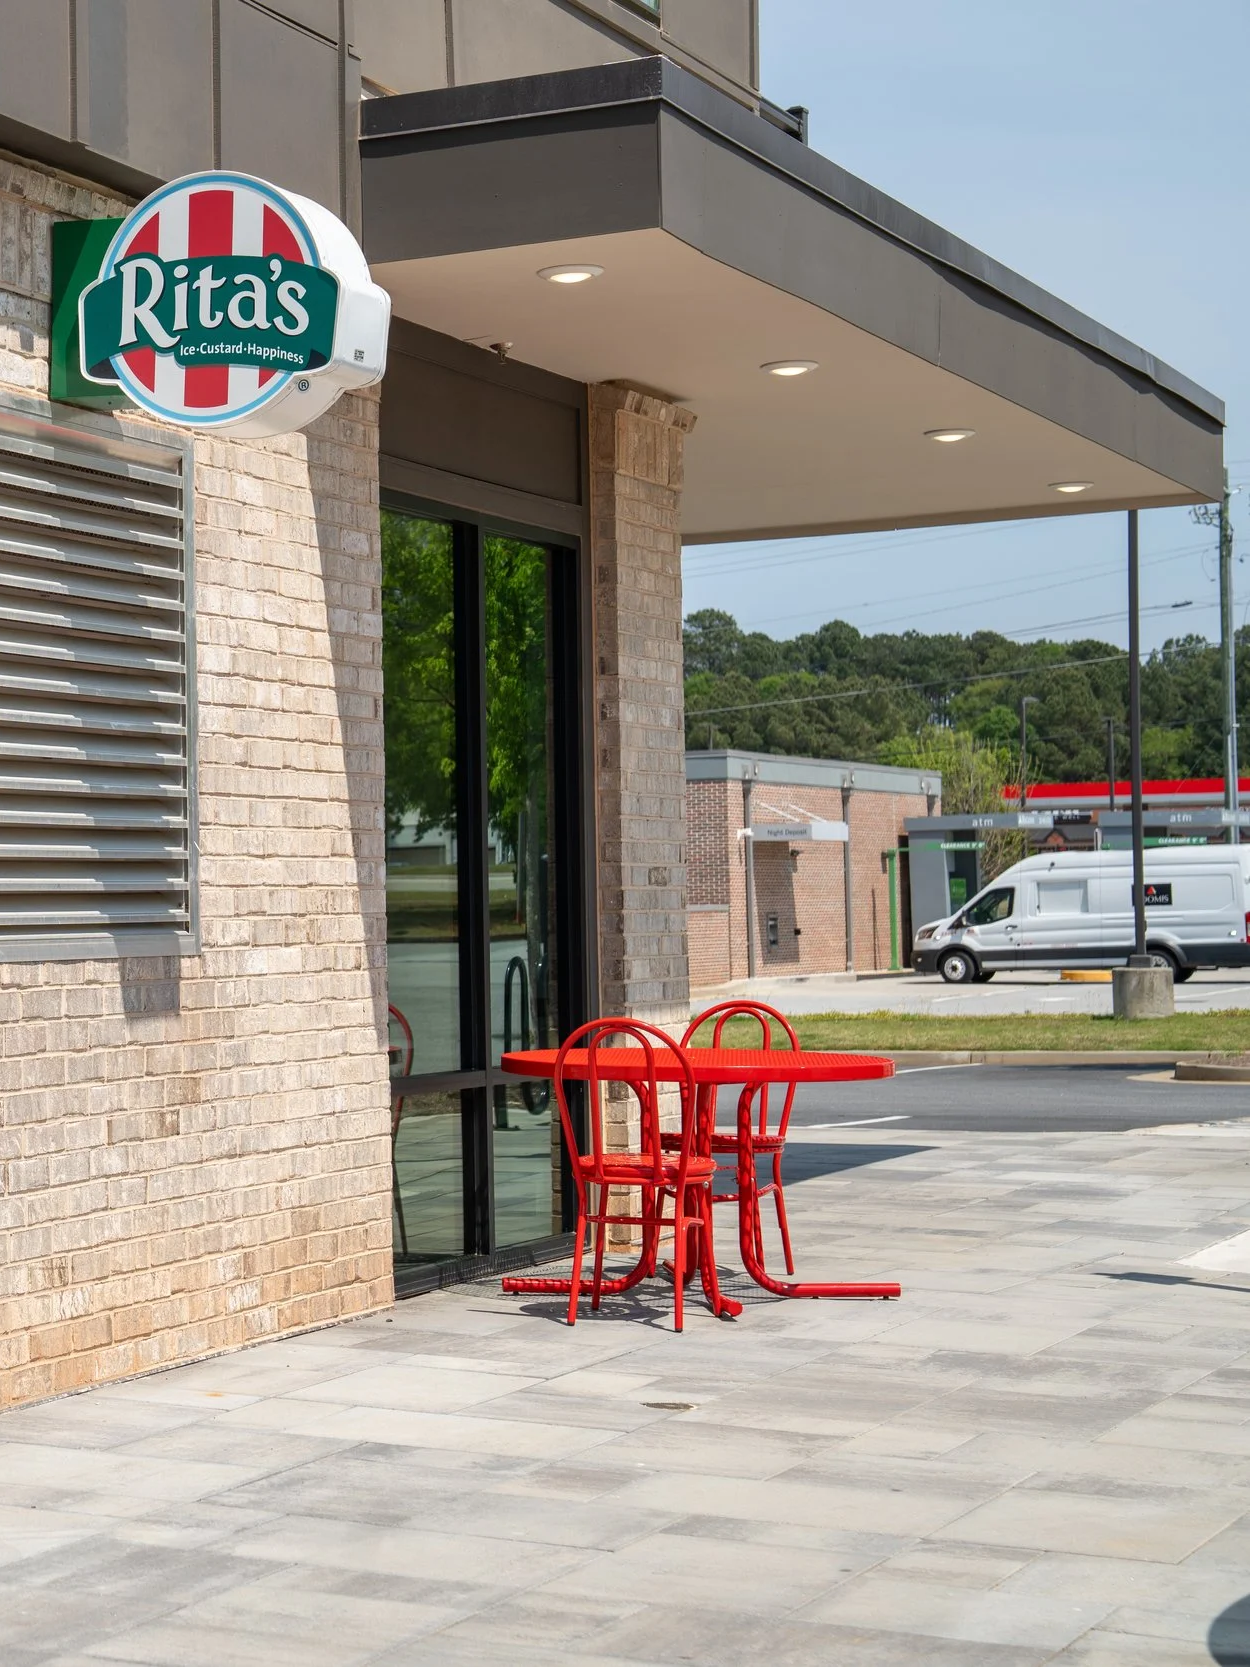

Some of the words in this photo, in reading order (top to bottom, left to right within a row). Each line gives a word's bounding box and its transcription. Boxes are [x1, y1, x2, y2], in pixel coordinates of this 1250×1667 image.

[118, 258, 310, 349] Rita's
[972, 818, 993, 827] atm
[1170, 813, 1192, 823] atm
[767, 828, 784, 837] Night
[785, 828, 808, 837] Deposit
